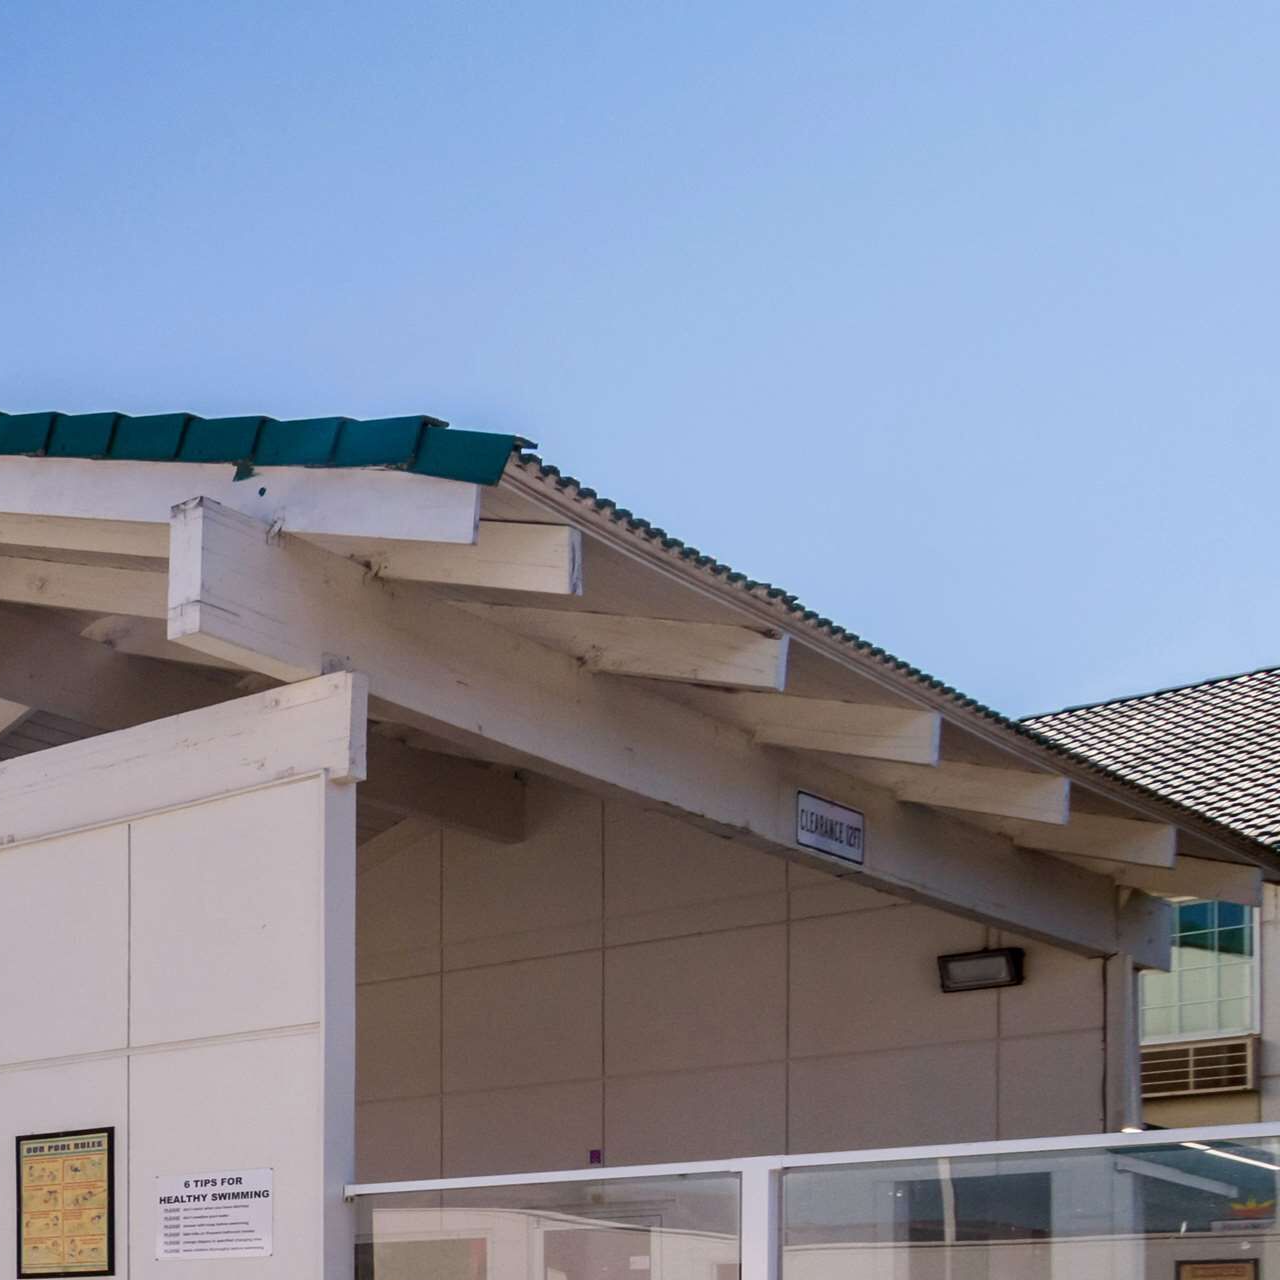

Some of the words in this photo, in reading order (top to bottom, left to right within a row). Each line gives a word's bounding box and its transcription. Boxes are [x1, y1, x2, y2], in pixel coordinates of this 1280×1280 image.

[800, 808, 844, 845] CLEARANCE
[48, 1143, 71, 1152] POOL
[74, 1140, 103, 1149] RULES
[184, 1180, 191, 1188] 6
[193, 1178, 217, 1188] TIPS
[221, 1177, 243, 1186] FOR
[159, 1193, 208, 1204] HEALTHY
[211, 1189, 270, 1202] SWIMMING
